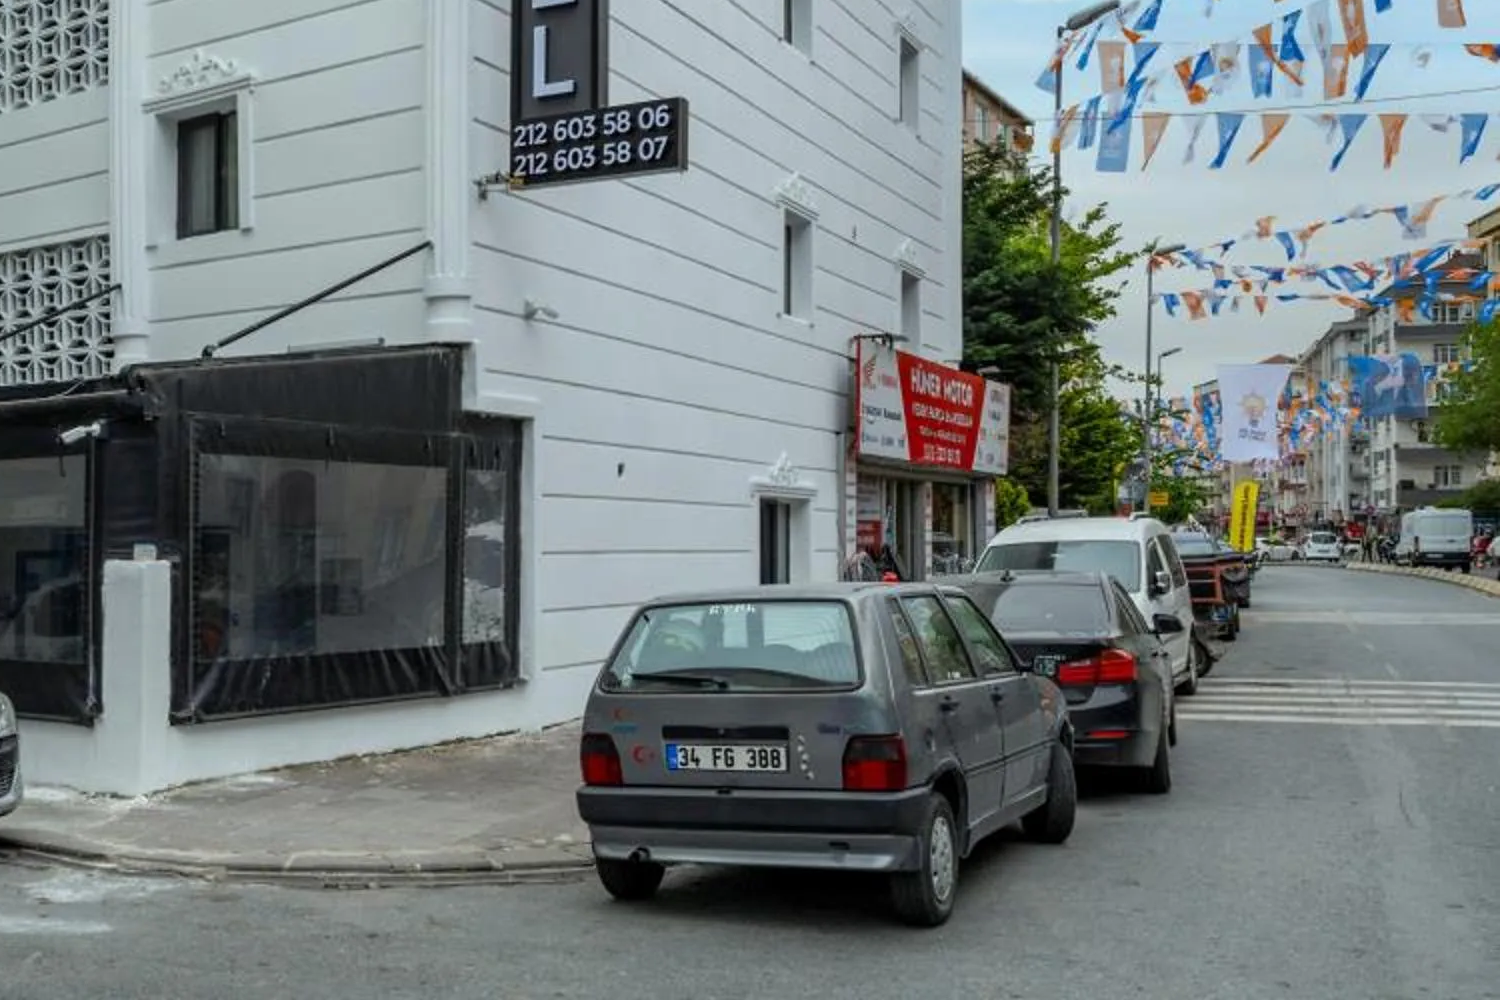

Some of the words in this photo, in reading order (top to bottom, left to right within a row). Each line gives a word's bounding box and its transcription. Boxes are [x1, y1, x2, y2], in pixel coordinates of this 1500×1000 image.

[513, 122, 547, 148] 212
[553, 115, 596, 141] 603
[602, 110, 631, 135] 58
[638, 104, 670, 129] 06
[513, 152, 548, 177] 212
[553, 145, 596, 171] 603
[602, 141, 631, 165] 58
[638, 135, 669, 161] 07
[943, 379, 973, 407] MOTOR
[678, 747, 701, 767] 34
[712, 748, 735, 768] FG
[746, 748, 781, 768] 388
